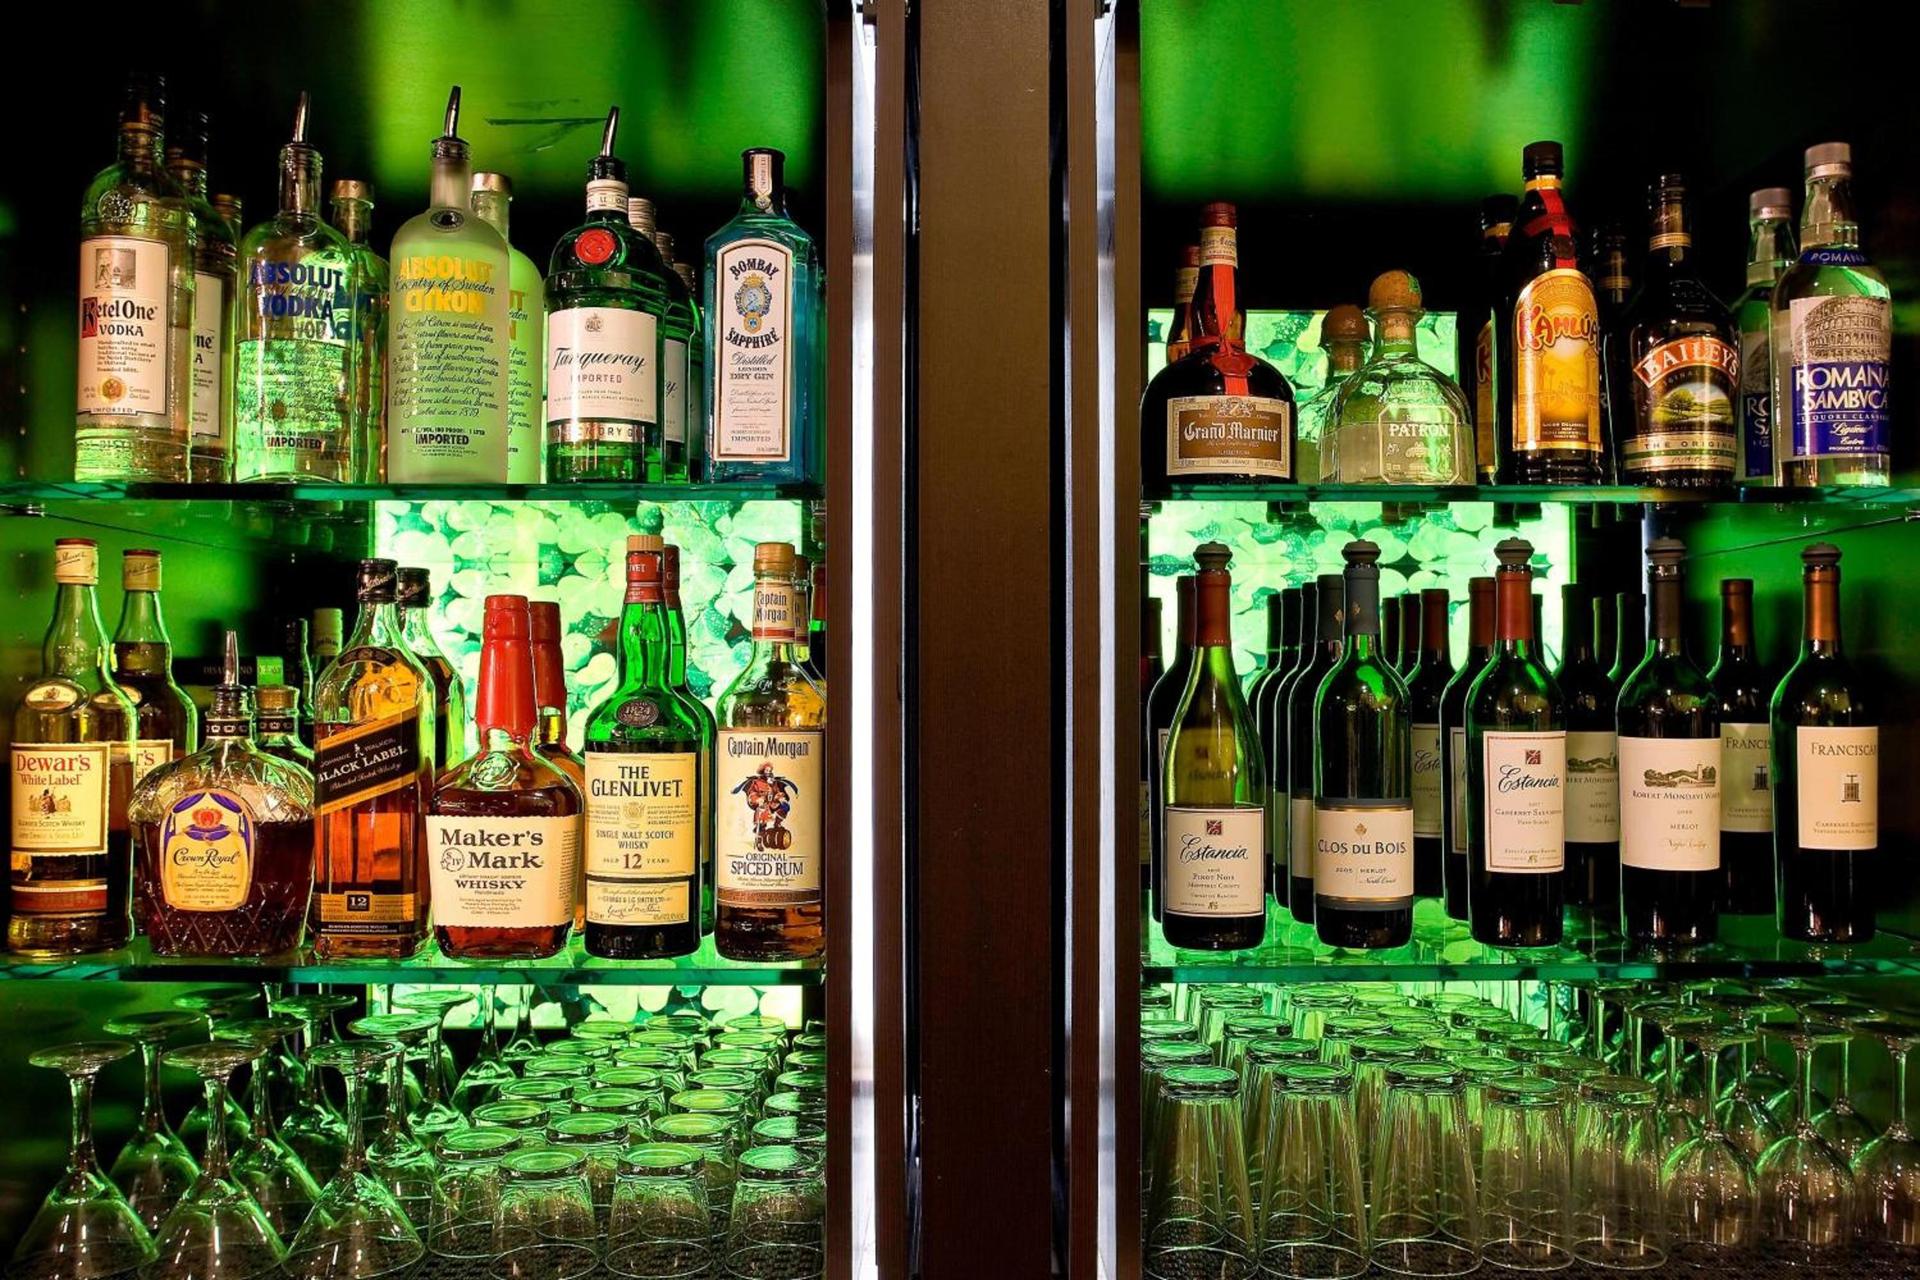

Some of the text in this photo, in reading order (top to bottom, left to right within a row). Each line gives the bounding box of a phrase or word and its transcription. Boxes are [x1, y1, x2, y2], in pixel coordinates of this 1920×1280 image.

[250, 262, 344, 290] ABSOLUT
[399, 255, 492, 281] ABSOLUT
[729, 258, 779, 278] BOMBAY
[438, 277, 455, 296] of
[451, 276, 495, 296] Sweden
[261, 294, 335, 320] VODKA
[404, 288, 486, 317] CITRON
[82, 297, 156, 339] Ketel One
[99, 324, 145, 337] VODKA
[725, 327, 780, 349] SAPPHIRE
[729, 351, 778, 366] Distilled
[1643, 341, 1740, 381] BAILEYS
[571, 374, 622, 384] IPORTED
[1796, 366, 1890, 391] ROMANA
[1801, 413, 1847, 422] LQUORE
[415, 433, 470, 446] IMPORTED
[1184, 421, 1279, 442] Grand Marnier
[267, 437, 322, 449] IMPORTED
[756, 591, 787, 606] Captain
[755, 607, 787, 623] Morgan
[727, 736, 808, 759] Captain Morgan
[16, 754, 90, 771] Dewar's
[318, 745, 408, 783] BLACK LABEL
[19, 773, 81, 786] White Label
[618, 766, 649, 779] THE
[1498, 764, 1560, 793] Estancia
[591, 779, 682, 797] GLENLIVET
[1633, 790, 1660, 799] ROBERT
[1664, 792, 1704, 800] MONDAVI
[440, 828, 543, 847] Maker's
[596, 830, 674, 839] SINGLE MALT SCOTCH
[618, 841, 649, 849] WHISKY
[1179, 833, 1248, 864] Estancia
[1318, 839, 1348, 854] CLOS
[1375, 841, 1407, 855] BOIS
[173, 847, 238, 869] Crown Royal
[467, 851, 543, 869] Mark
[623, 854, 642, 869] 12
[745, 853, 788, 862] ORIGINAL
[730, 861, 803, 877] SPICED RUM
[454, 880, 527, 889] WHISKY
[350, 897, 367, 907] 12
